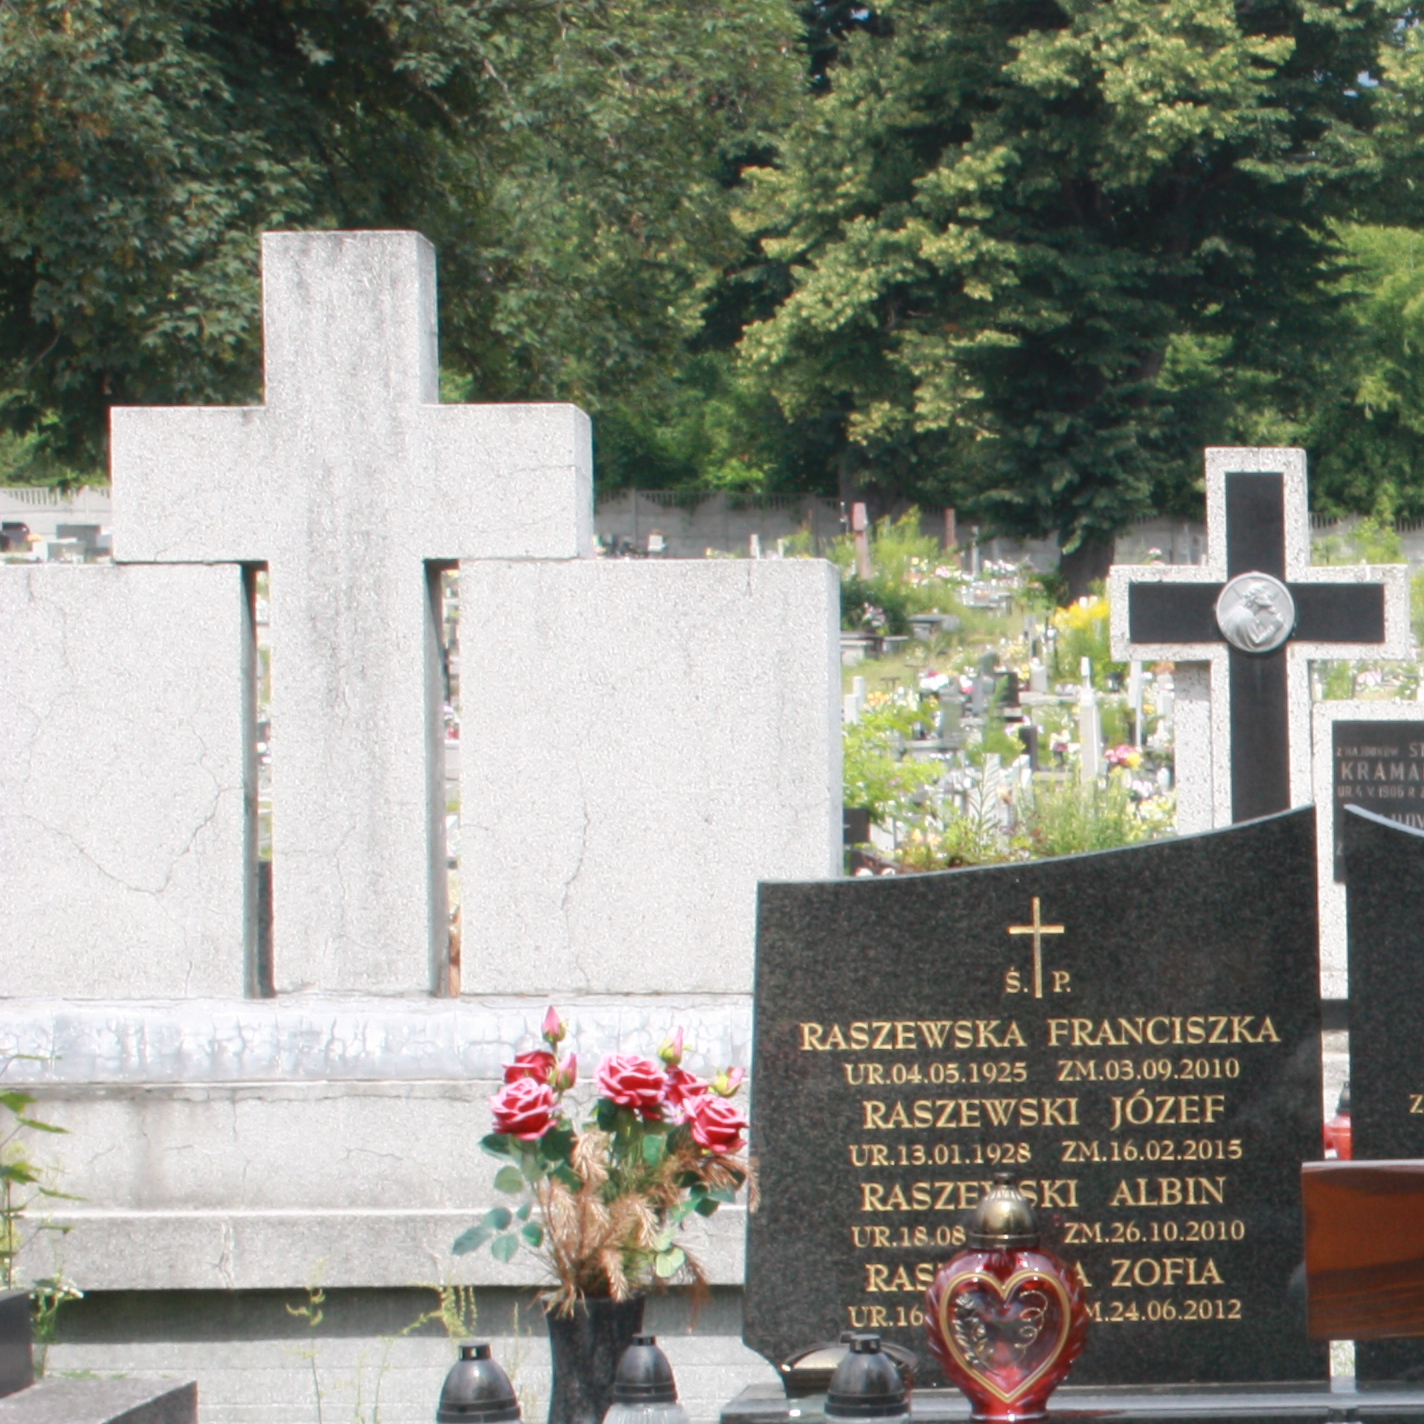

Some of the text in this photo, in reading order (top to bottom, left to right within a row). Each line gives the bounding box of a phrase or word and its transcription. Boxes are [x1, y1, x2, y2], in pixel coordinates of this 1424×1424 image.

[800, 1015, 1282, 1052] RASZEWSKA FRANCISZKA
[843, 1057, 1241, 1086] UR.04.05.1925 ZM.03.09.2010
[862, 1085, 1226, 1131] RASZEWSKI JÓZEF
[849, 1138, 1244, 1168] UR.13.01.1928 ZM.16.02.2015
[860, 1175, 1227, 1212] RASZESKI ALBIN
[1063, 1218, 1246, 1244] ZM.26.10.2010
[1110, 1257, 1225, 1288] ZOFIA
